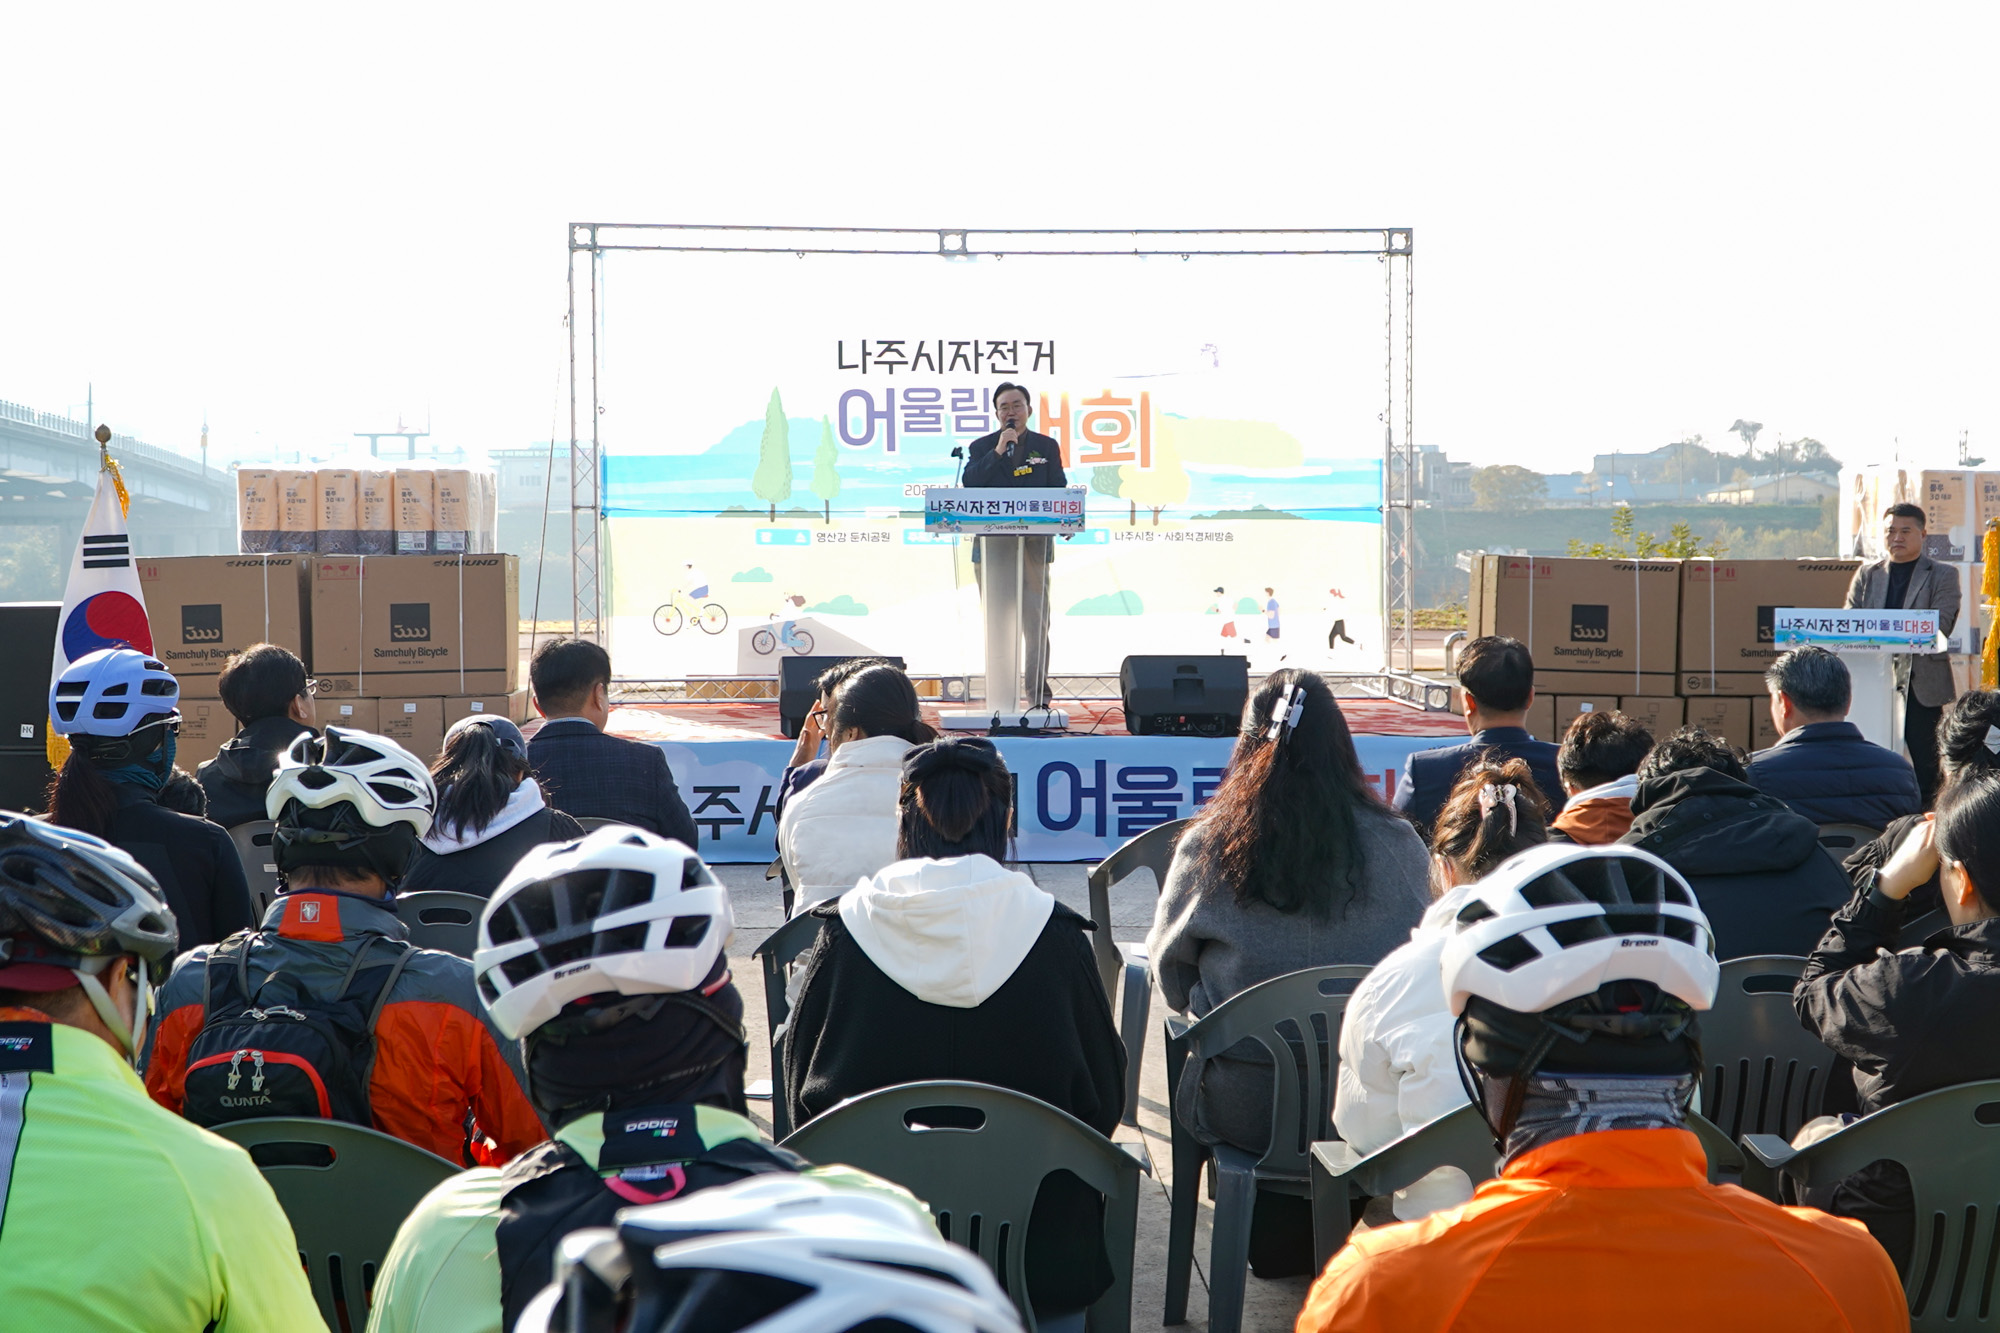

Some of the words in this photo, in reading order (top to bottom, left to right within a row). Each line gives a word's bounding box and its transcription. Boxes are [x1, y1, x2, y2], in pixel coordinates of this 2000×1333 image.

[838, 339, 1055, 375] 나주시자전거
[816, 531, 847, 543] 영산강
[850, 531, 891, 543] 둔치공원
[1114, 531, 1155, 542] 나주시청
[1164, 531, 1235, 542] 사회적경제방송
[235, 559, 293, 567] HOUND
[443, 559, 499, 567] HOUND
[1622, 564, 1676, 573] HOUND
[166, 650, 208, 661] Samchuly
[374, 648, 416, 660] Samchuly
[417, 646, 449, 659] Bicycle
[1554, 646, 1594, 659] Samchuly
[1595, 648, 1624, 659] Bicycle
[625, 1119, 679, 1133] DODICI
